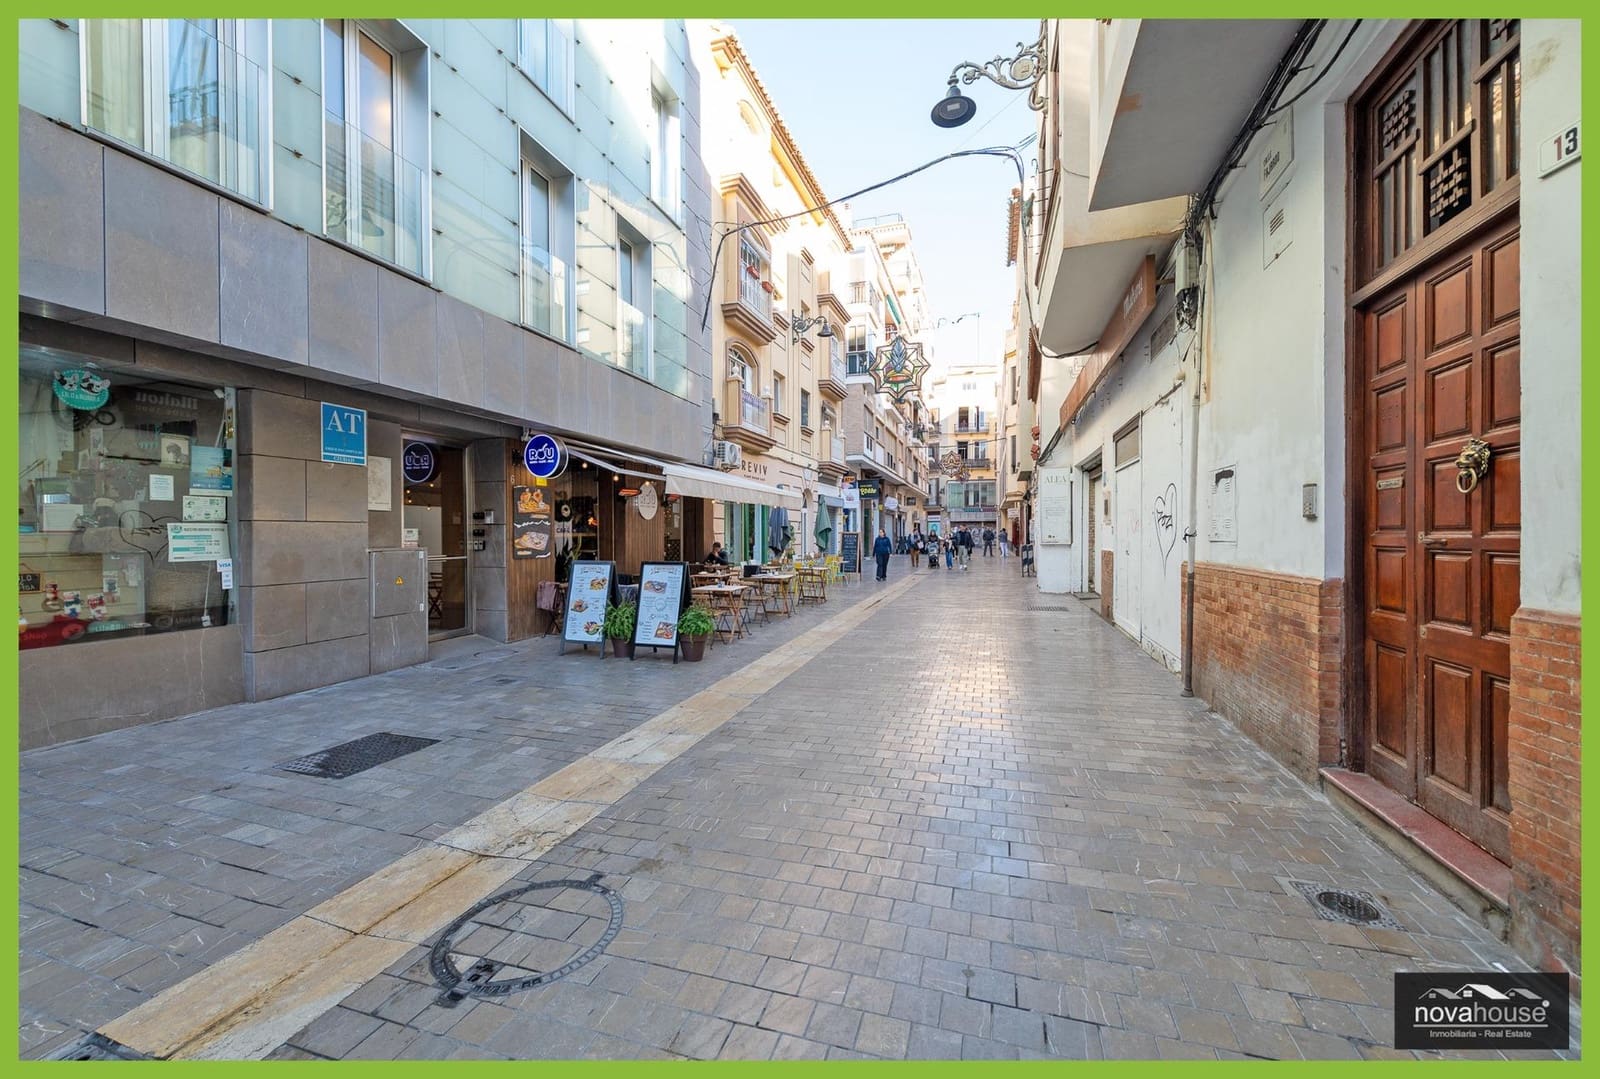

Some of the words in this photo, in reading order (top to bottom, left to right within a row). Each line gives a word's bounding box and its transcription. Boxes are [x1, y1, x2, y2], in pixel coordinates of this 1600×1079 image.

[1554, 127, 1577, 161] 13
[325, 410, 361, 435] AT
[741, 460, 767, 475] REVIV
